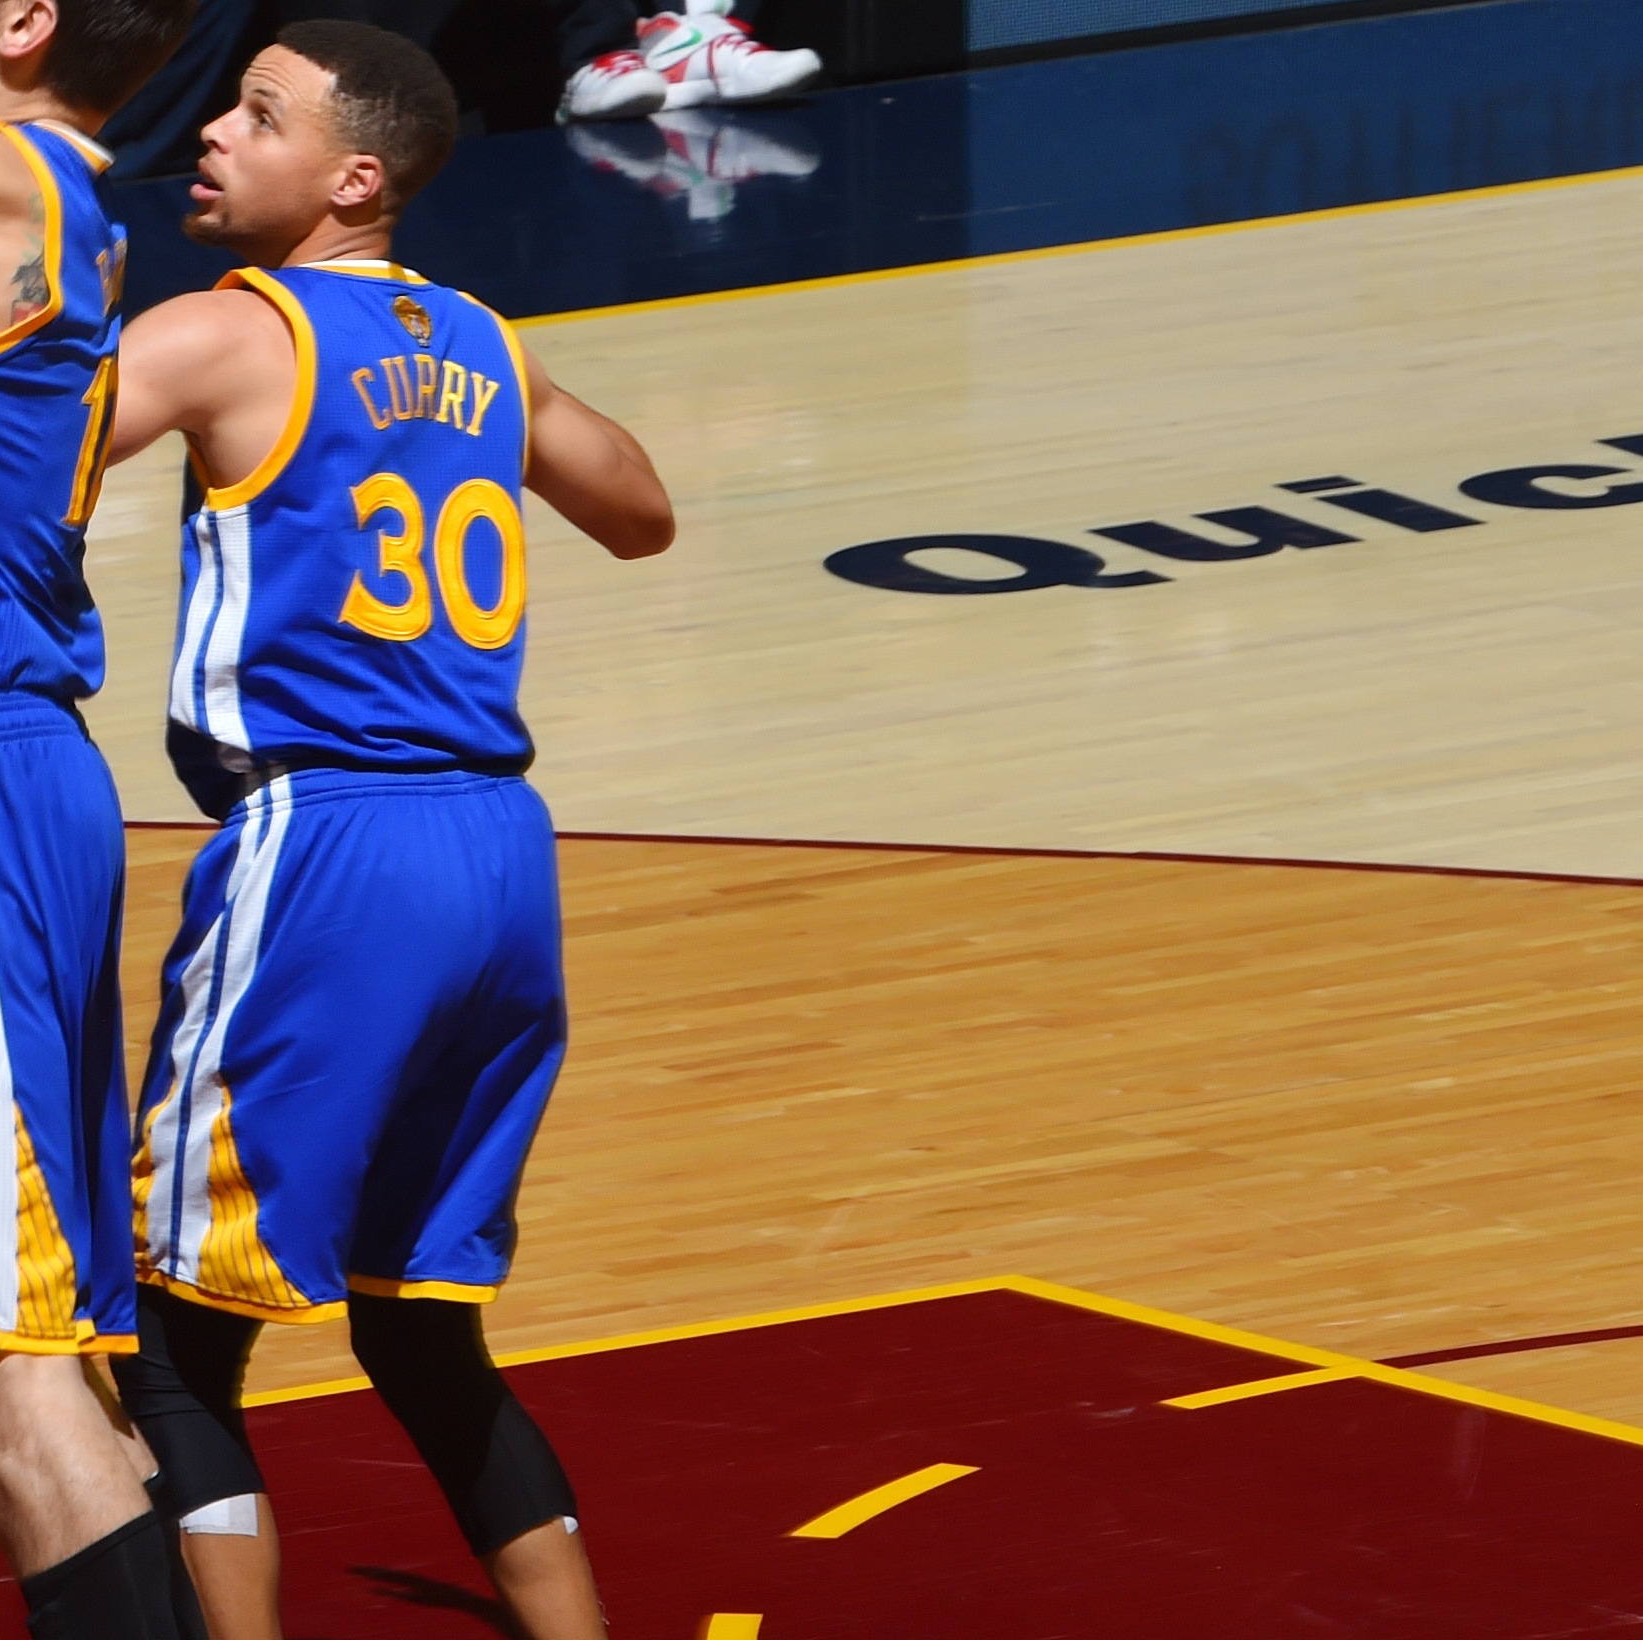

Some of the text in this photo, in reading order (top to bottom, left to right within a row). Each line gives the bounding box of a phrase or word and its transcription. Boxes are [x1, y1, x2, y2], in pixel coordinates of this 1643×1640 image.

[351, 352, 500, 438] CURRY
[338, 470, 529, 652] 30
[822, 433, 1643, 596] Quic
